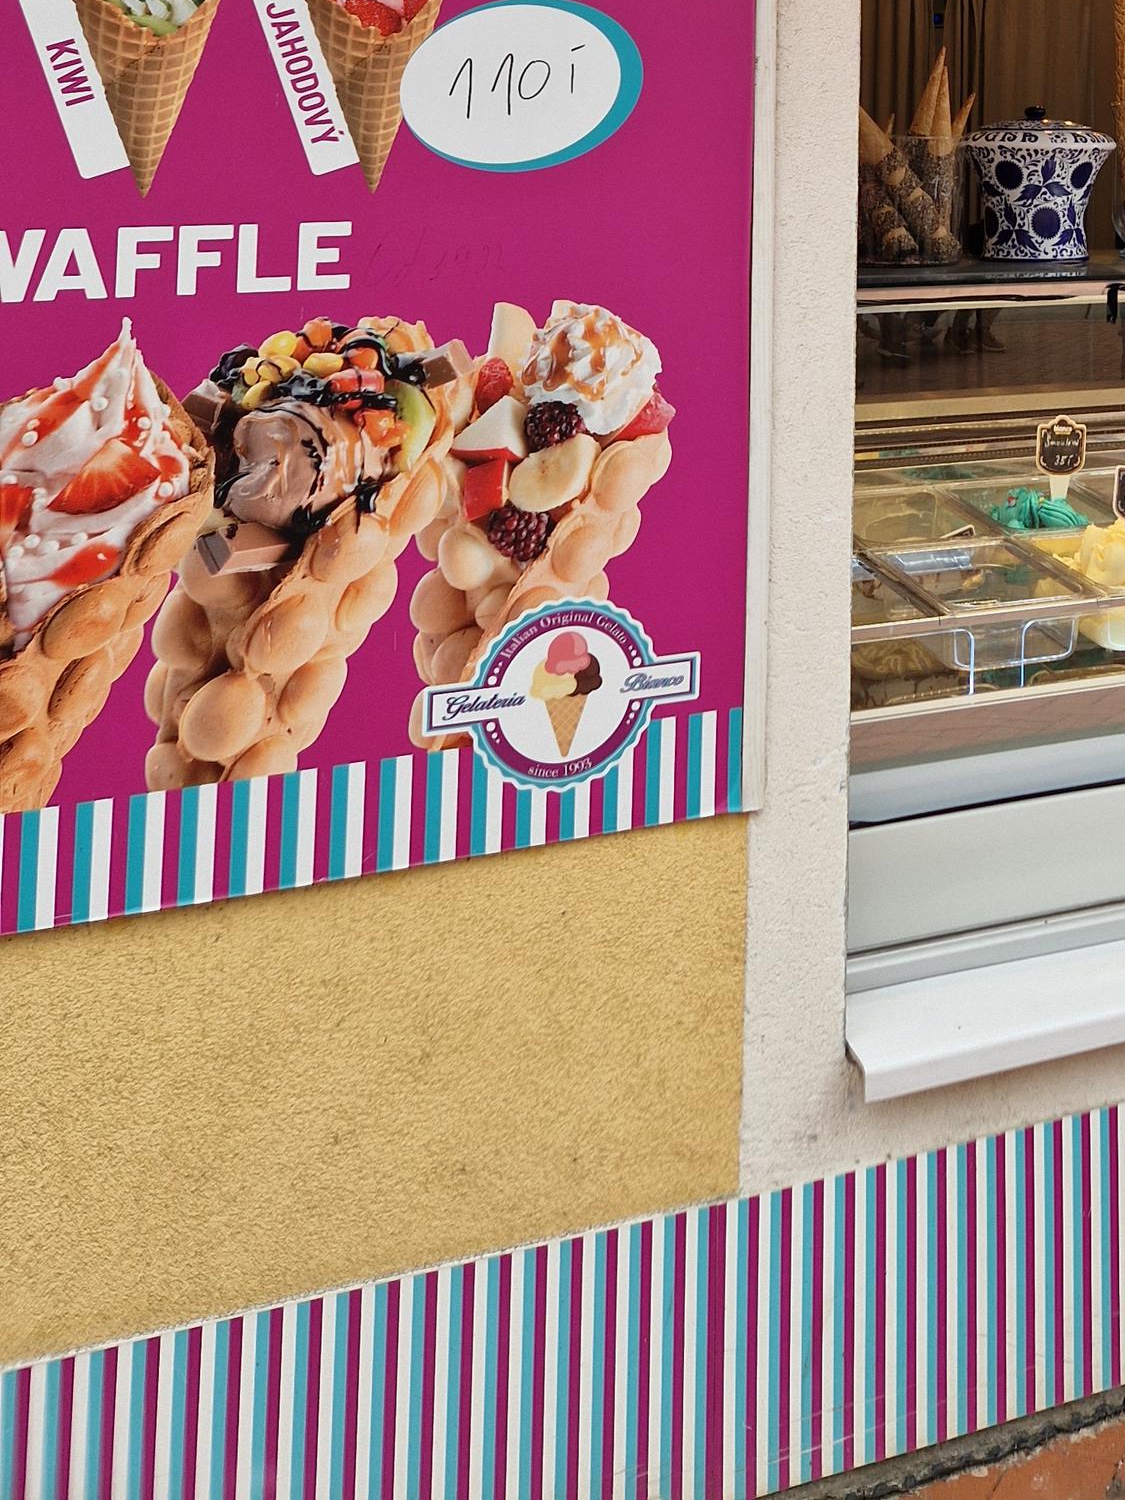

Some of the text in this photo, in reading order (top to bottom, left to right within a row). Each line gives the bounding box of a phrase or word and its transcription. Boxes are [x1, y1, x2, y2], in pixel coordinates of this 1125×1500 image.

[46, 38, 95, 107] KIWI
[266, 3, 344, 144] JAHODOVÝ
[500, 611, 627, 659] Italian Original Gelato
[619, 671, 685, 694] Bianco
[442, 691, 527, 722] Gelateria
[527, 757, 592, 778] since 1993
